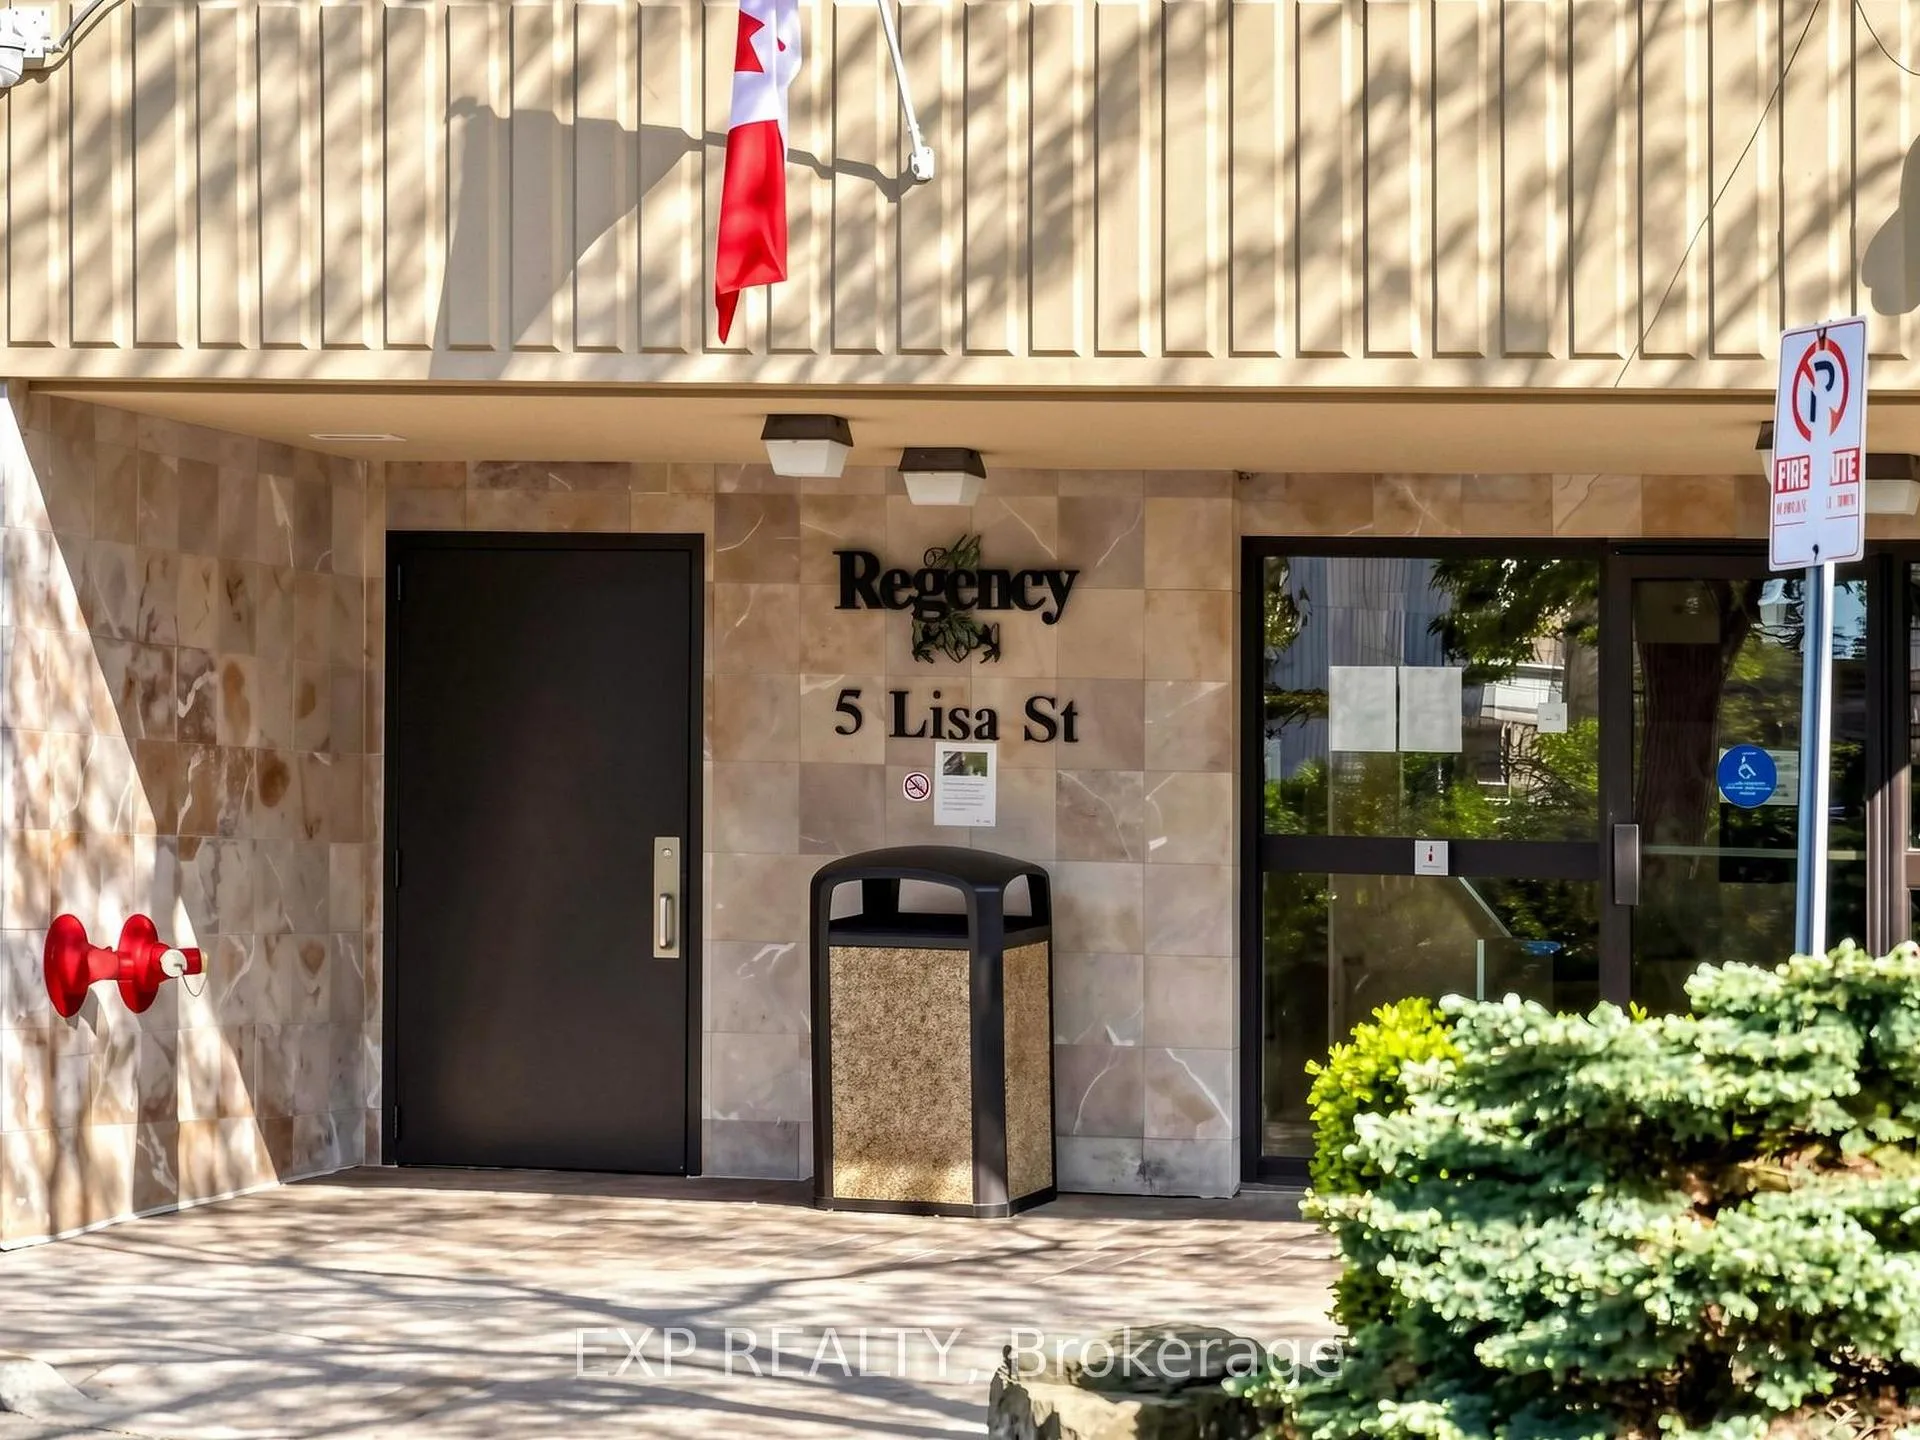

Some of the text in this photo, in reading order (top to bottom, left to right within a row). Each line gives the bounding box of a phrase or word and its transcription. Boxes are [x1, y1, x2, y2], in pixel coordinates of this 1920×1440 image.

[1777, 457, 1809, 491] FIRE
[832, 550, 1080, 625] Regency
[834, 689, 1079, 743] 5 Lisa St
